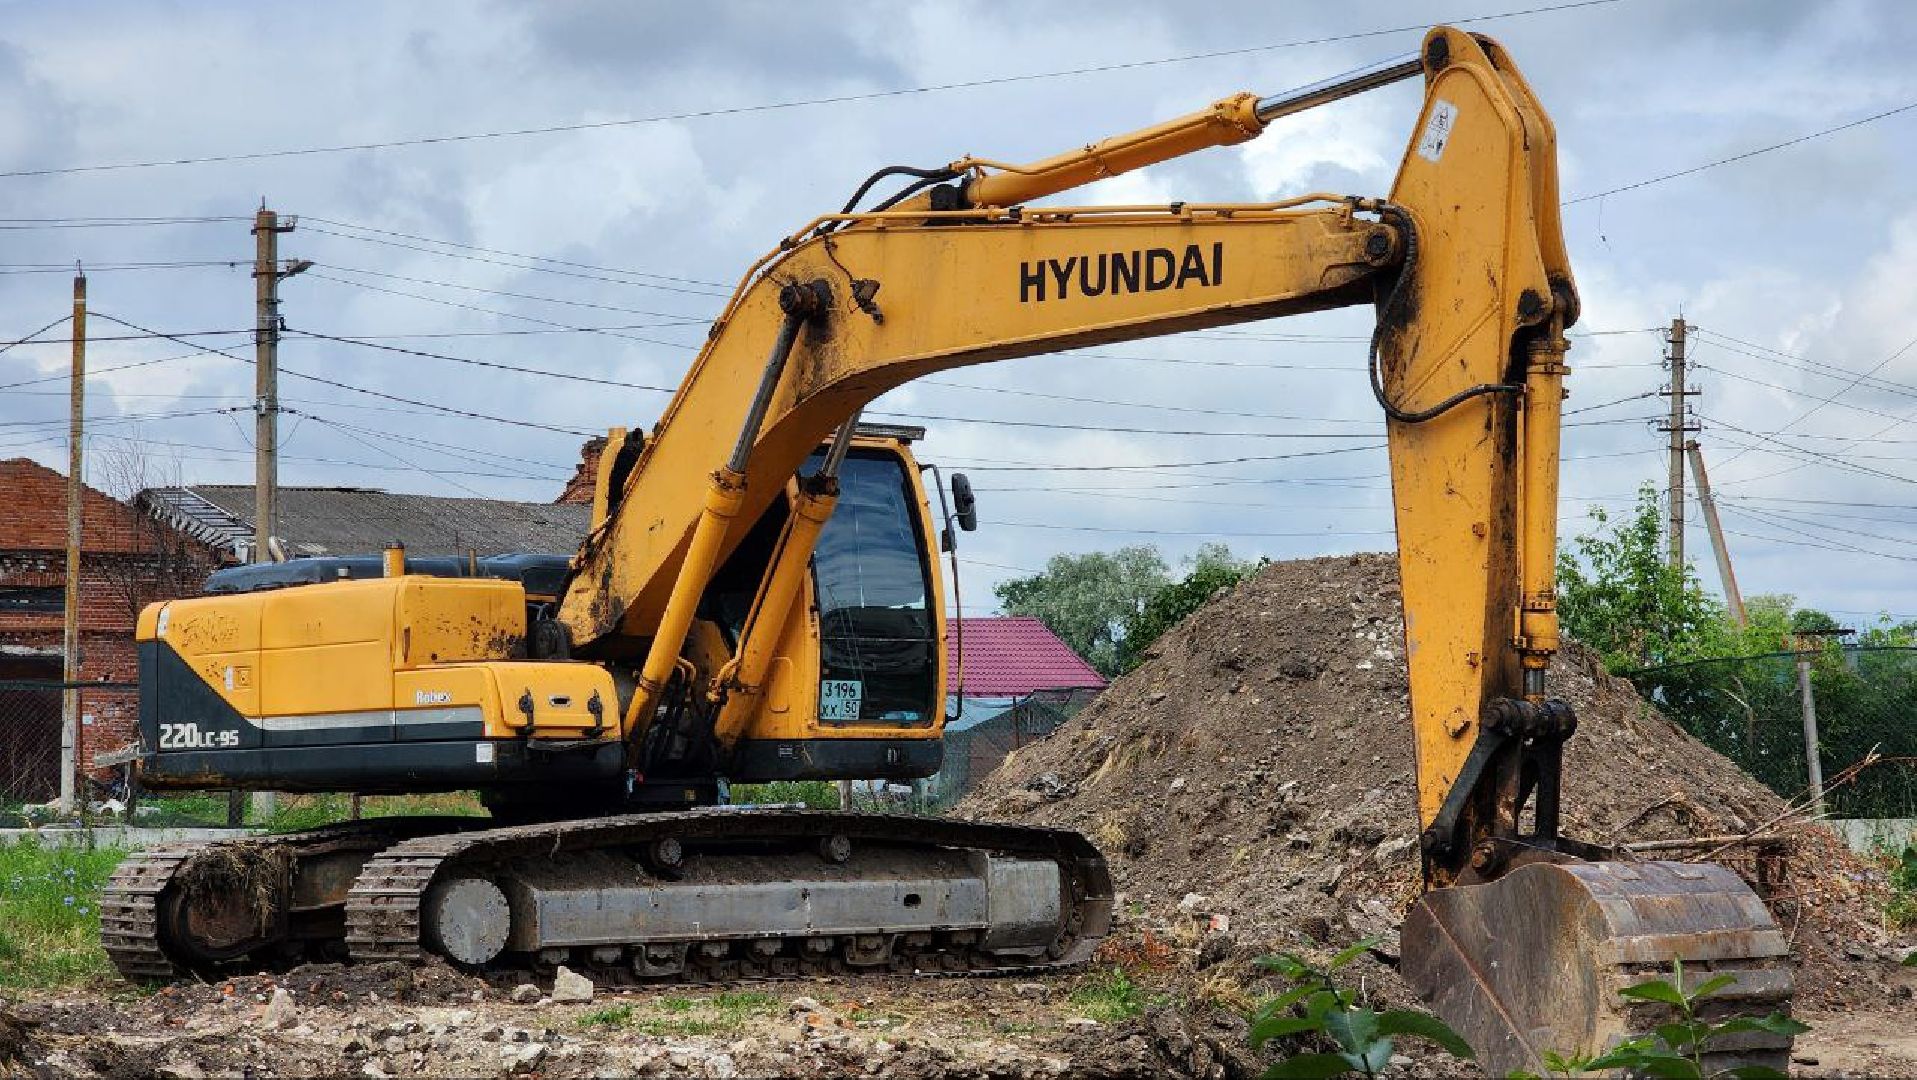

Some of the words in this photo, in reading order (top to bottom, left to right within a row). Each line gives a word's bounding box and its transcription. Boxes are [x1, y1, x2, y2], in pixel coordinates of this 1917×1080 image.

[1020, 242, 1223, 302] HYUNDAI
[825, 682, 857, 698] 3196
[845, 701, 857, 714] 50
